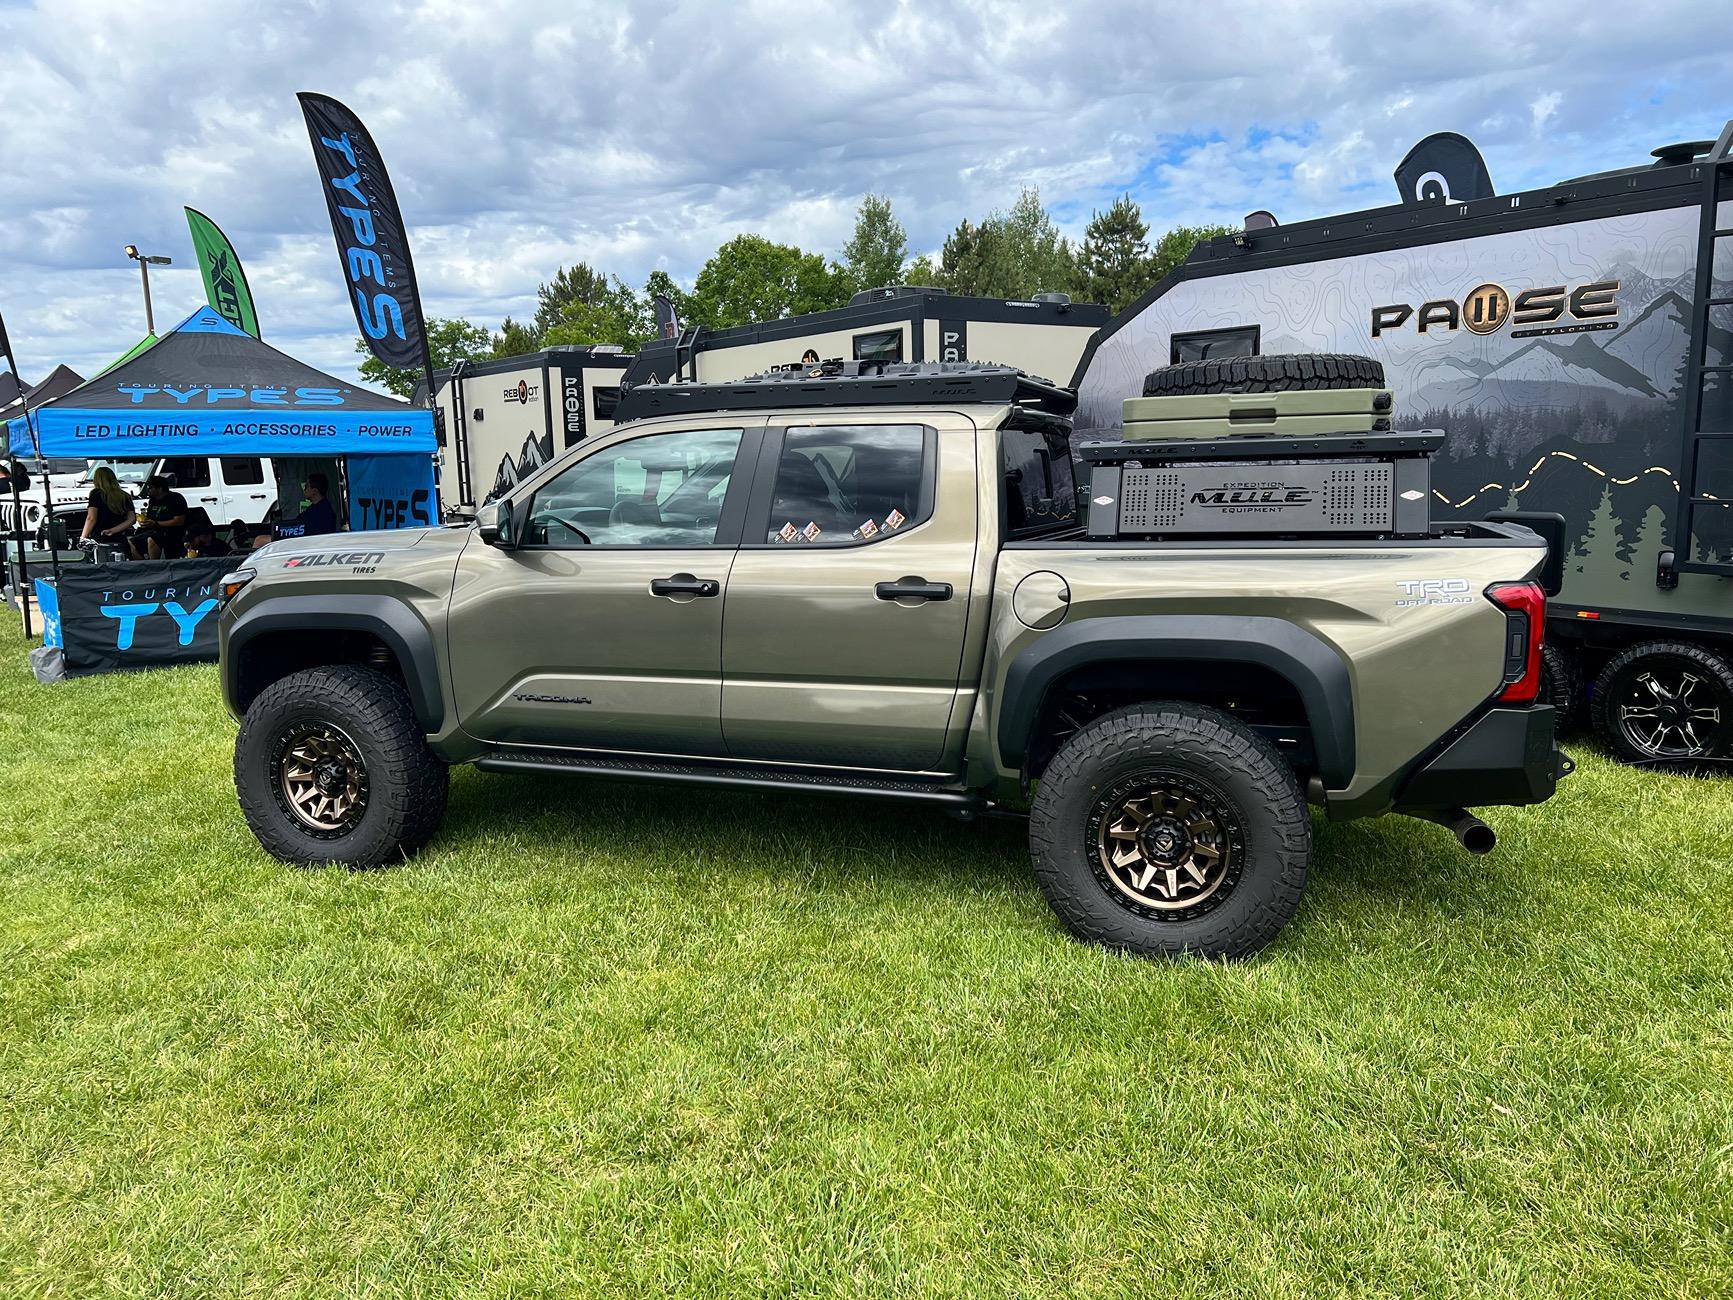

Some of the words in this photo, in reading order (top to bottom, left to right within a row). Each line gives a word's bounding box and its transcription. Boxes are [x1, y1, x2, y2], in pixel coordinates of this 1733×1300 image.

[350, 132, 381, 217] TOURING
[378, 230, 397, 289] ITEMS
[321, 132, 406, 340] TYPES
[1541, 323, 1615, 335] PALOMINO
[229, 383, 288, 391] ITEMS
[117, 387, 346, 406] TYPES
[75, 425, 111, 438] LED
[116, 424, 199, 437] LIGHTING
[223, 423, 337, 437] ACCESSORIES
[358, 425, 412, 437] POWER
[279, 525, 305, 537] TYPES
[283, 552, 386, 569] FALKEN
[352, 566, 377, 574] TIRES
[1396, 579, 1471, 599] TRD
[513, 694, 592, 704] TACOMA
